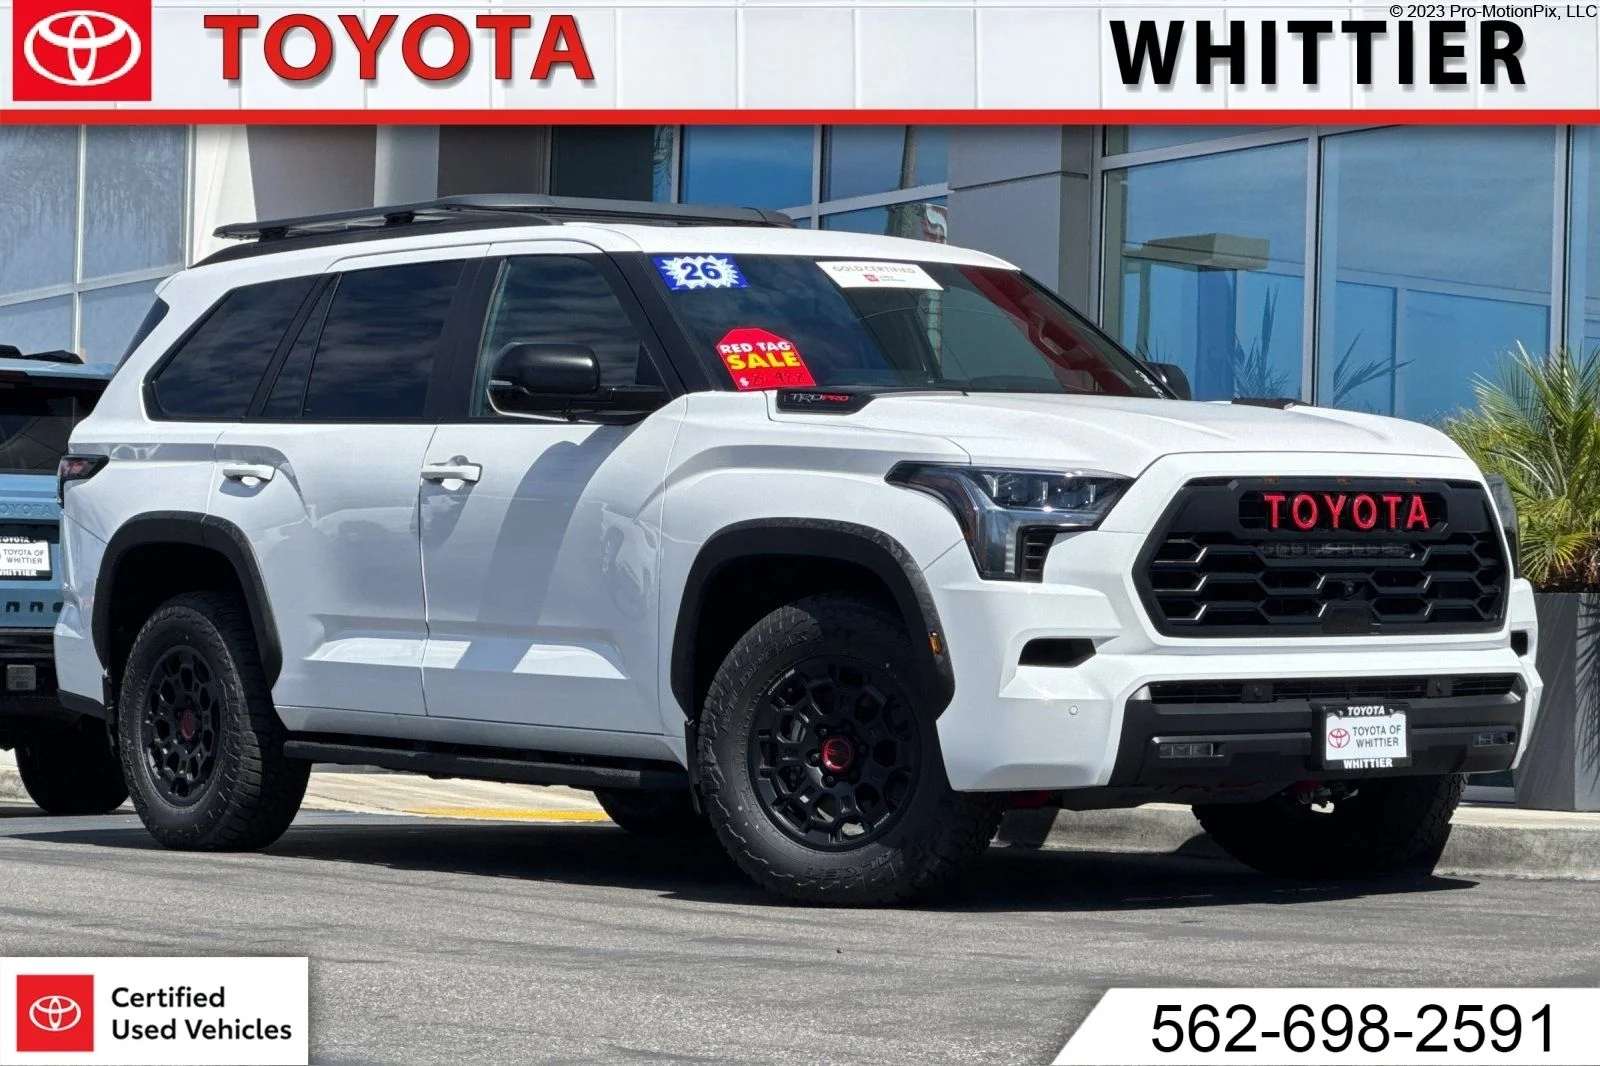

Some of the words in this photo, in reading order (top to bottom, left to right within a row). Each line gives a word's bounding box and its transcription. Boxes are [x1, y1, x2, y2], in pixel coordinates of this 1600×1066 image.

[681, 262, 722, 280] 26
[720, 342, 753, 354] RED
[756, 340, 791, 352] TAG
[726, 351, 801, 370] SALE
[1264, 494, 1430, 529] TOYOTA
[1347, 706, 1386, 716] TOYOTA
[1352, 726, 1387, 736] TOYOTA
[1389, 725, 1402, 735] OF
[1356, 737, 1399, 748] WHITTIER
[1343, 758, 1393, 769] WHITTIER
